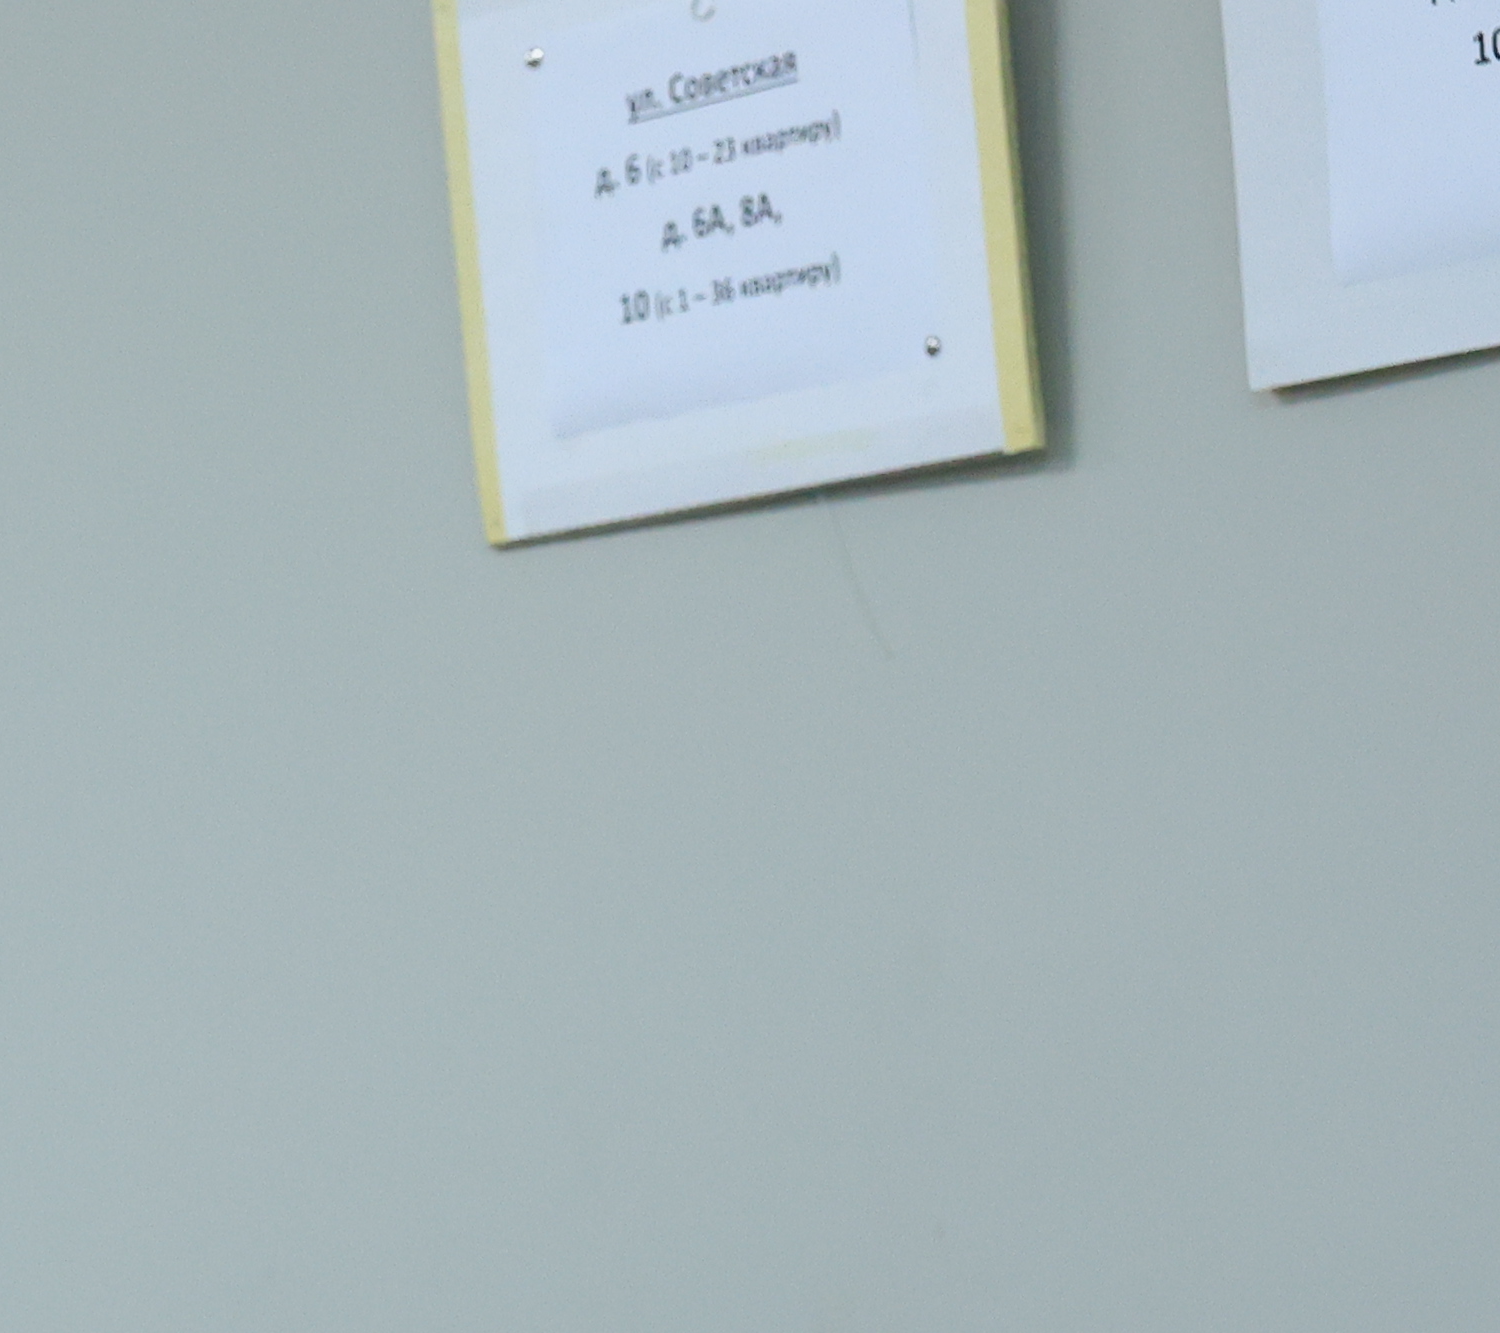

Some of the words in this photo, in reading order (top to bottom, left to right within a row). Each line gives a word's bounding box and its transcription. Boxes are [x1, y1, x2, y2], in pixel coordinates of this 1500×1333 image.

[626, 88, 663, 124] ул.
[668, 50, 797, 105] Советская
[594, 167, 620, 199] д.
[625, 153, 642, 185] 6
[670, 148, 693, 176] 10
[713, 137, 736, 165] 23
[743, 109, 841, 156] квартиру)
[661, 220, 687, 252] д.
[691, 203, 735, 239] 6А,
[620, 290, 650, 325] 10
[678, 289, 690, 313] 1
[740, 250, 841, 299] квартиру)
